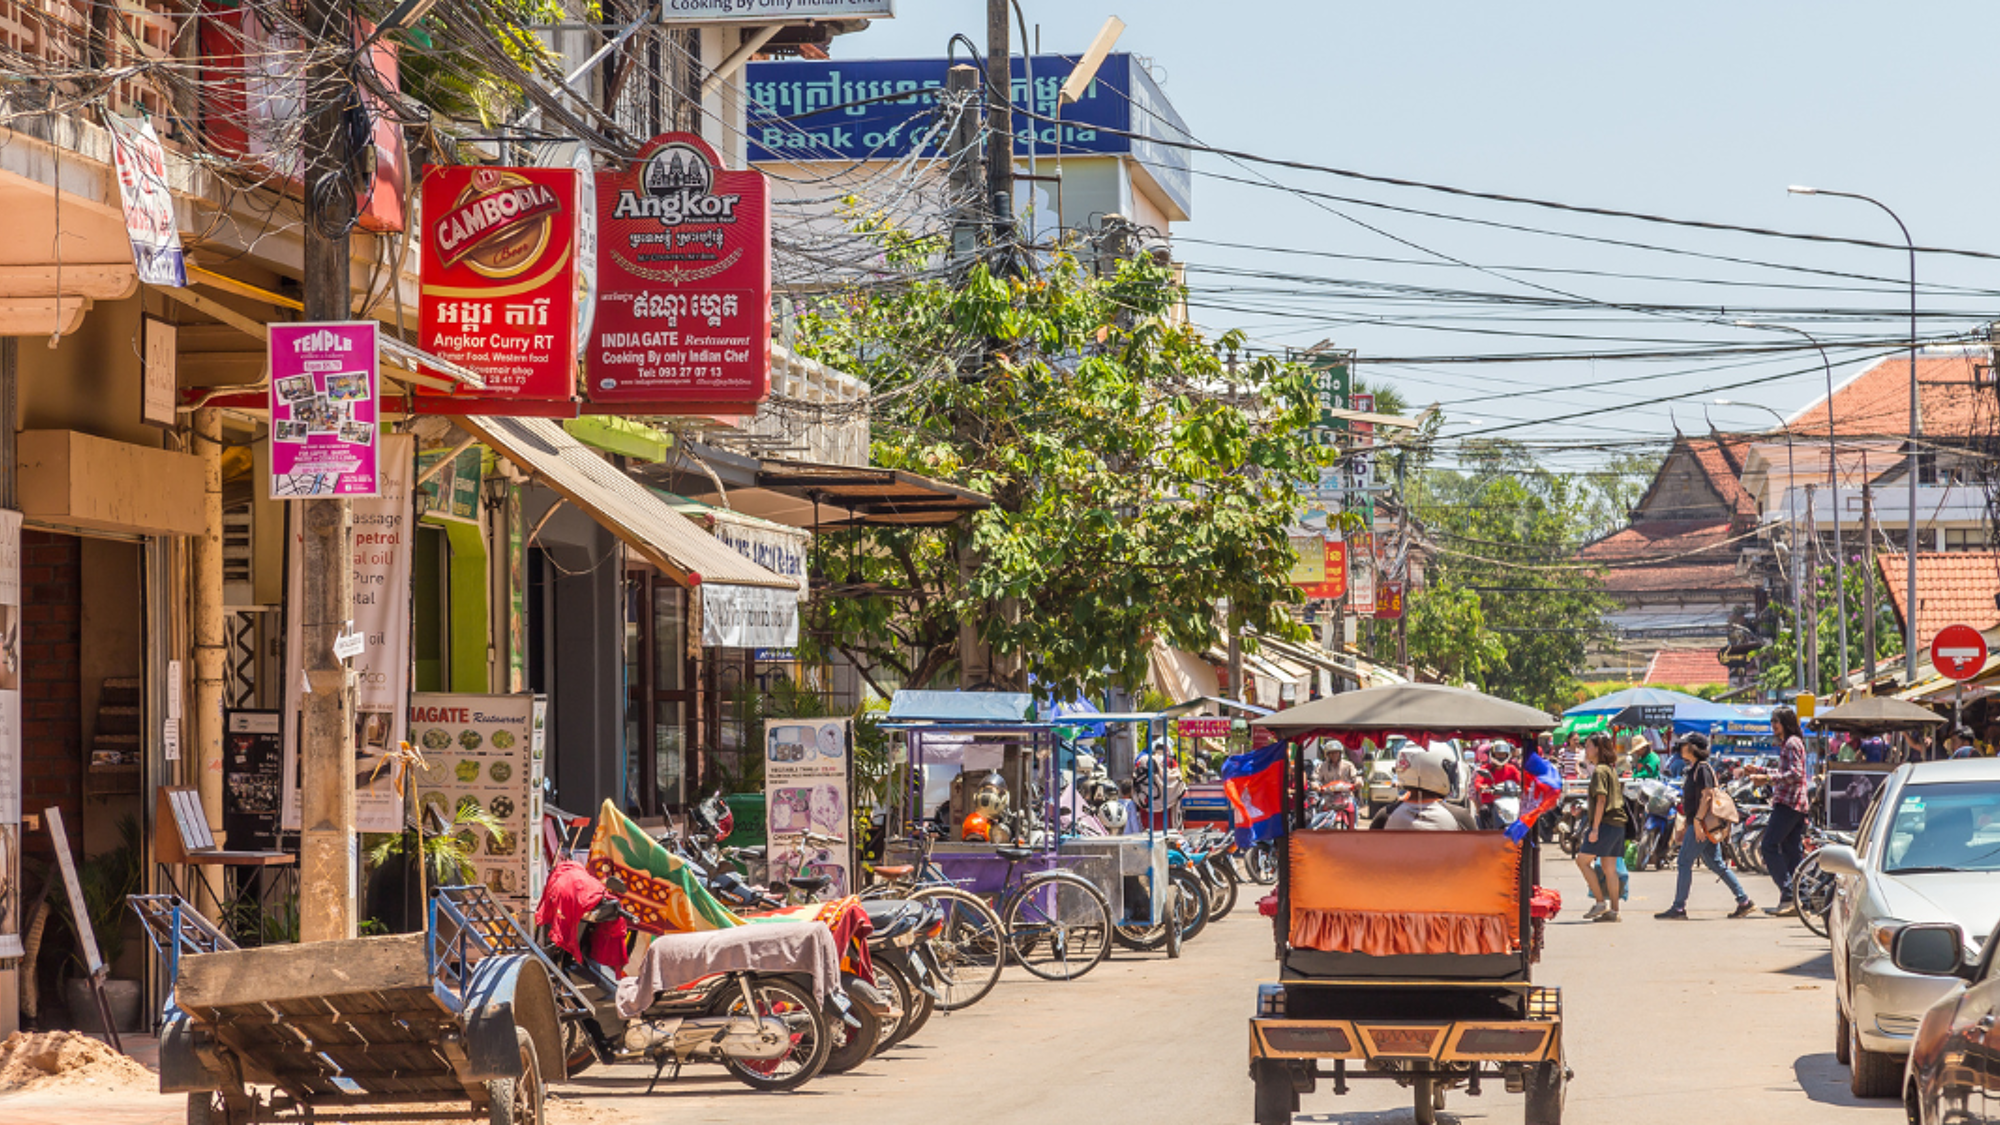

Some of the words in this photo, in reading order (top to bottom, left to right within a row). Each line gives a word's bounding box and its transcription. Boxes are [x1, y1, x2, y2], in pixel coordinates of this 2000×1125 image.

[671, 0, 732, 13] Cooking
[762, 127, 854, 148] Bank
[862, 126, 900, 147] of
[910, 125, 1097, 148] Codia
[612, 187, 741, 226] Angkor
[438, 185, 555, 250] CAMBODIA
[293, 330, 353, 353] TEMPLE
[433, 333, 487, 351] Angkor
[489, 333, 530, 352] Curry
[534, 335, 554, 350] RT
[602, 333, 641, 348] INDIA
[642, 331, 679, 347] GATE
[684, 335, 750, 346] Restaurant
[492, 353, 528, 362] Western
[529, 354, 549, 363] food
[602, 350, 645, 366] Cooking
[647, 350, 660, 367] By
[664, 350, 686, 365] only
[689, 349, 722, 363] Indian
[724, 349, 749, 363] Chef
[512, 364, 534, 376] shop
[638, 367, 656, 378] Tel:
[658, 366, 677, 378] 093
[679, 366, 692, 378] 27
[694, 366, 706, 378] 07
[710, 366, 722, 378] 13
[353, 514, 402, 528] assage
[356, 531, 400, 547] petrol
[369, 631, 385, 646] oil
[473, 711, 526, 724] Restaurant
